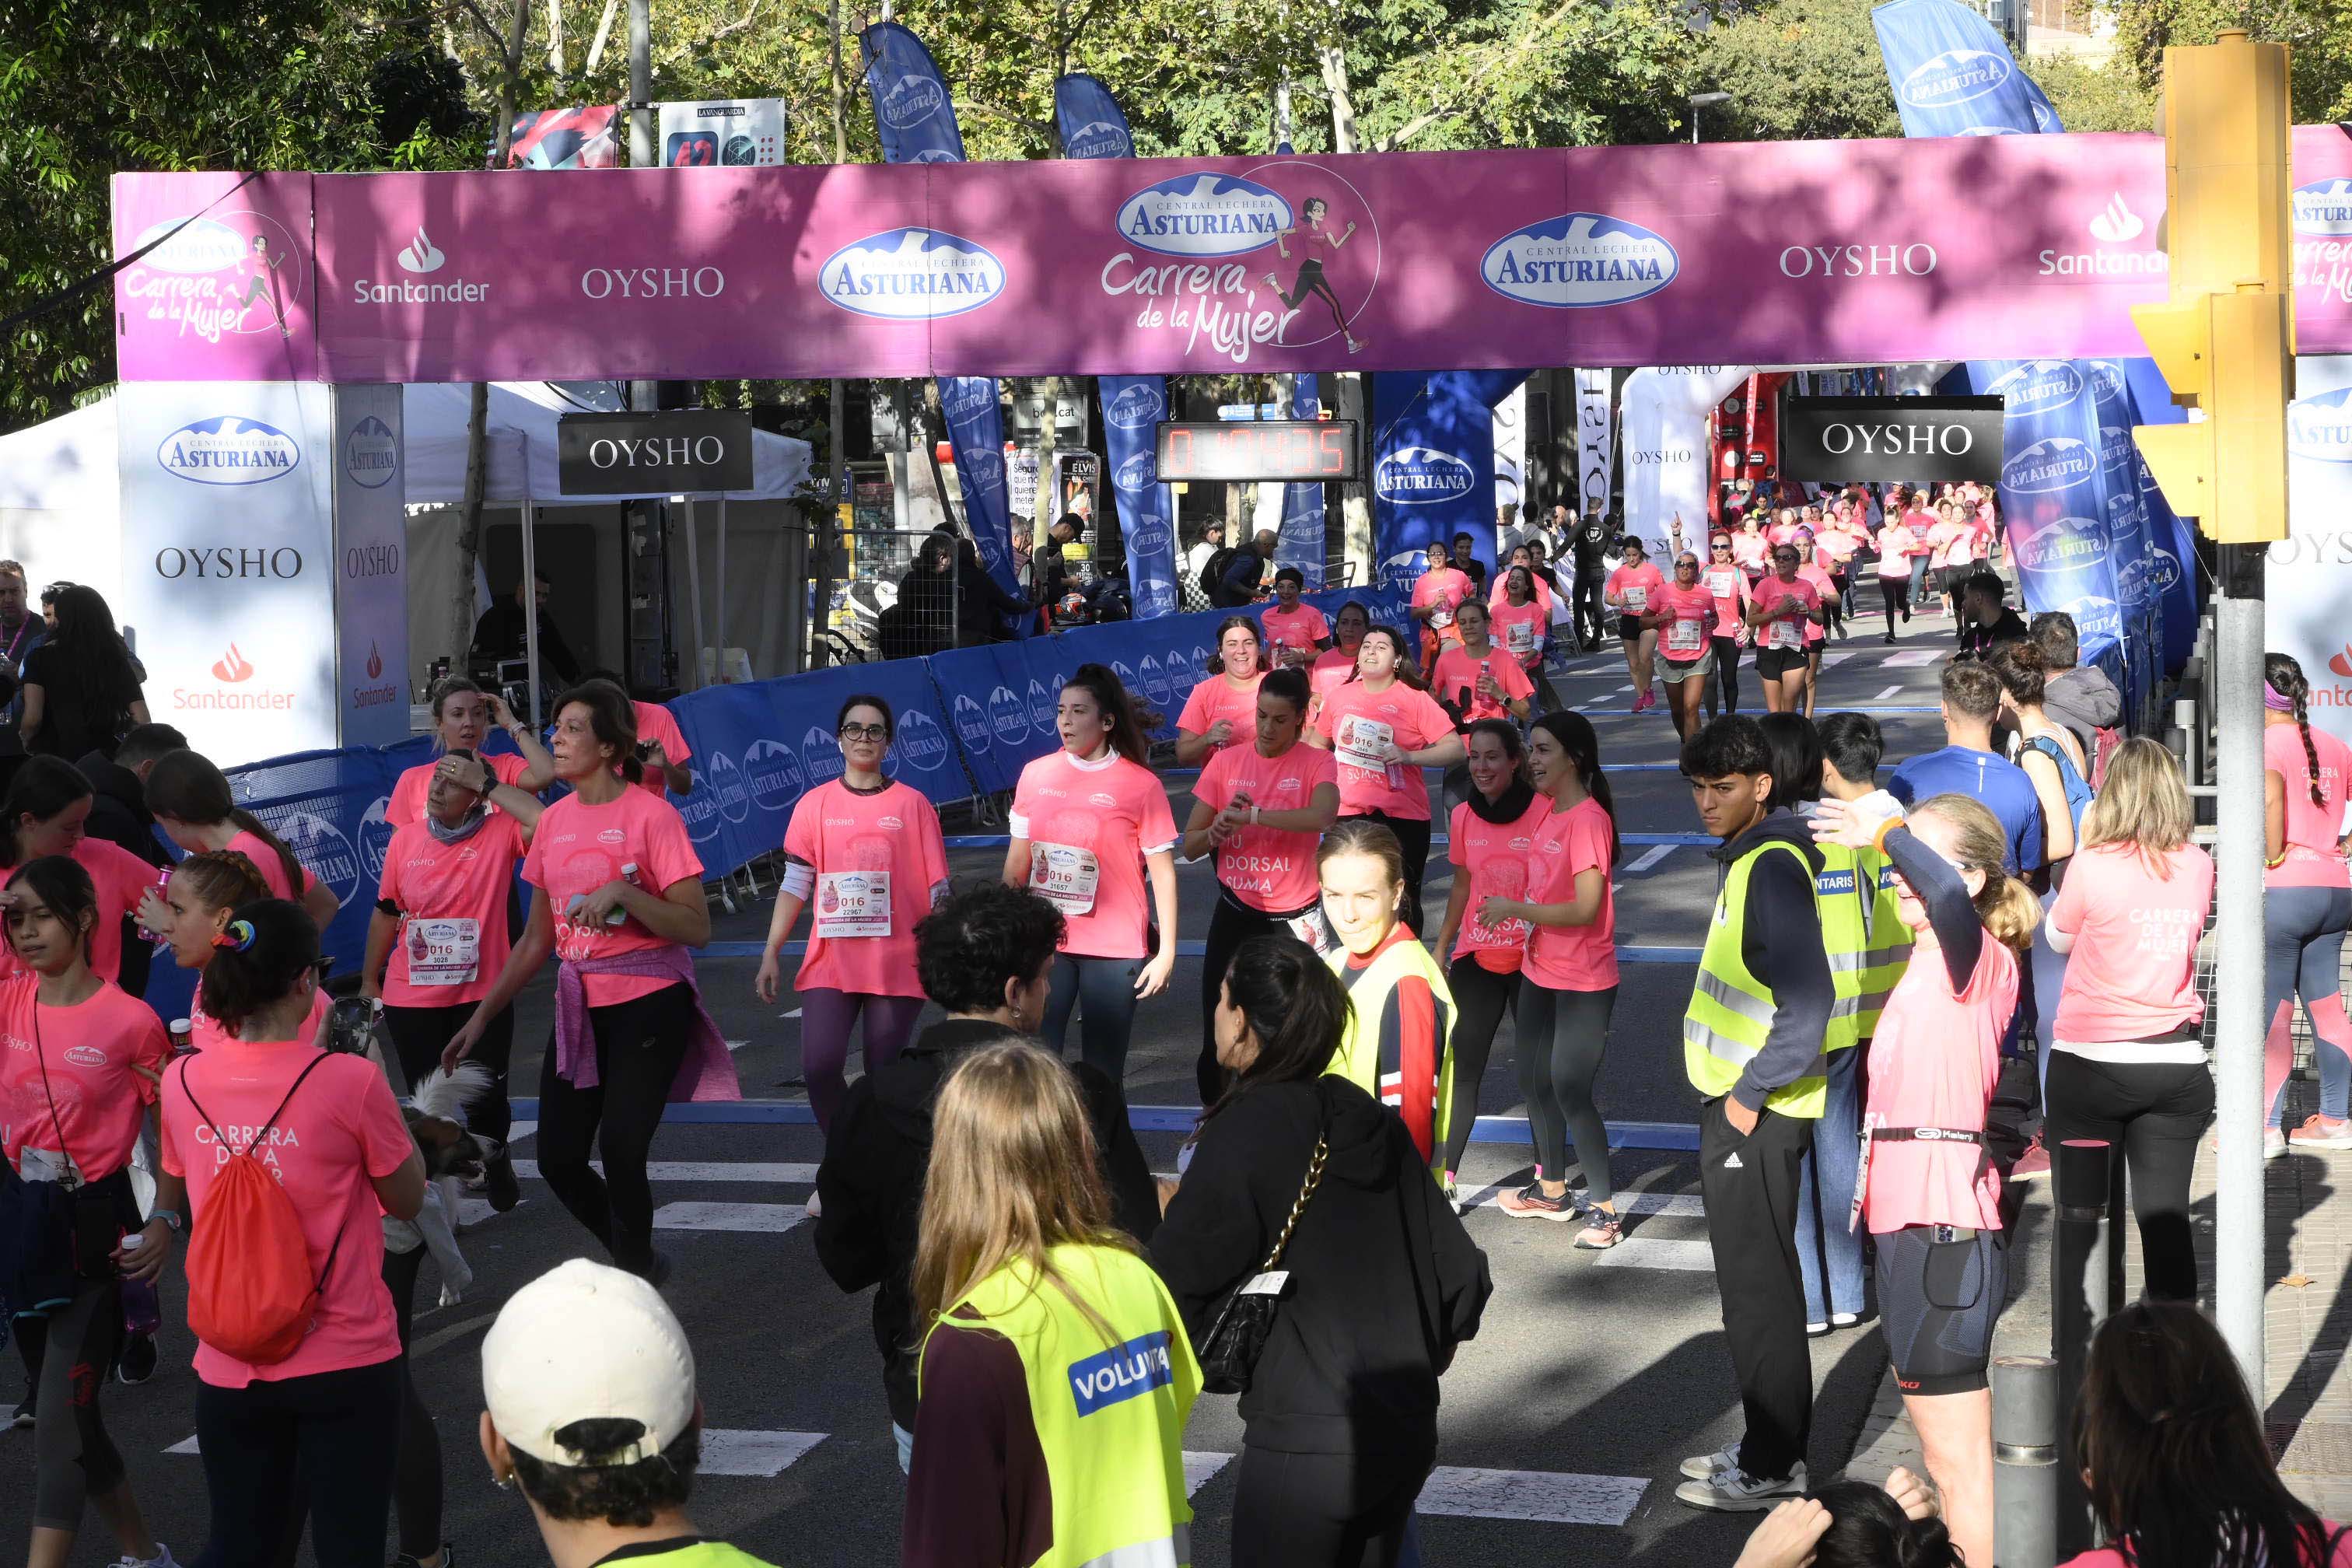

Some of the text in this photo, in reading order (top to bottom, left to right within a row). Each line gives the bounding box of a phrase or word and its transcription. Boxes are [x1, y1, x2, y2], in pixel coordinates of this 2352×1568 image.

[1157, 200, 1275, 211] CENTRAL LECHERA
[1130, 205, 1280, 236] ASTURIANA
[1527, 244, 1657, 257] CENTRAL LECHERA
[1496, 248, 1664, 285] ASTURIANA
[1780, 243, 1938, 278] OYSHO
[582, 267, 725, 299] OYSHO
[833, 261, 991, 296] ASTURIANA
[1101, 252, 1246, 296] Carrera
[124, 268, 217, 300] Carrera
[355, 278, 489, 303] Santander
[147, 294, 254, 343] de la Mujer
[1136, 290, 1301, 363] de la Mujer
[1822, 423, 1973, 455] OYSHO
[169, 441, 290, 468] ASTURIANA
[589, 436, 724, 468] OYSHO
[1633, 450, 1691, 465] OYSHO
[1072, 463, 1095, 473] ELVIS
[1378, 473, 1467, 492] ASTURIANA
[156, 547, 303, 579] OYSHO
[348, 544, 398, 579] OYSHO
[1080, 563, 1090, 572] 30
[173, 689, 296, 711] Santander
[354, 684, 397, 709] Santander
[1355, 737, 1373, 747] 016
[1228, 778, 1257, 788] OYSHO
[1039, 787, 1067, 798] OYSHO
[825, 818, 855, 827] OYSHO
[1226, 855, 1293, 872] DORSAL
[1049, 870, 1073, 883] 016
[1226, 876, 1272, 892] SUMA
[841, 897, 865, 907] 016
[2129, 908, 2200, 924] CARRERA
[2141, 923, 2188, 940] DE LA
[430, 945, 453, 954] 016
[2136, 938, 2189, 954] MUJER
[68, 1051, 104, 1063] ASTURIANA
[194, 1125, 300, 1147] CARRERA
[1942, 1130, 1974, 1143] Kalenji
